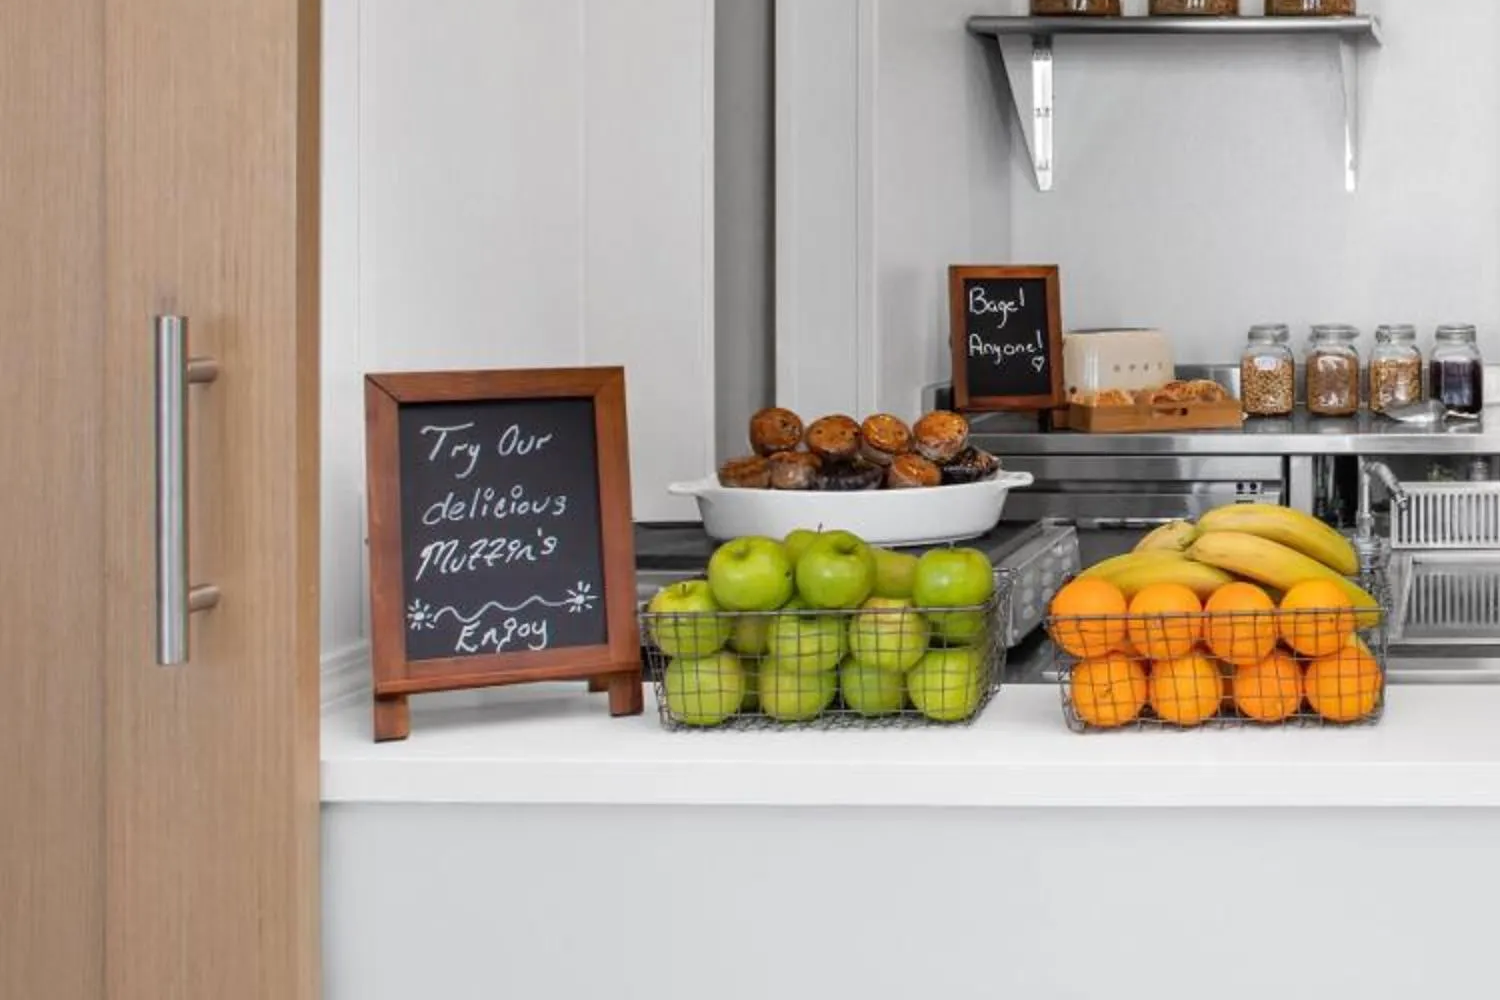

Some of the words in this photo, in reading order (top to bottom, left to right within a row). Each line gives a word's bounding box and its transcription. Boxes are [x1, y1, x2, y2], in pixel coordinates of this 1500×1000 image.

[420, 422, 480, 479] Try
[498, 424, 554, 456] Our
[422, 485, 567, 525] delicious
[455, 617, 548, 653] Enjoy
